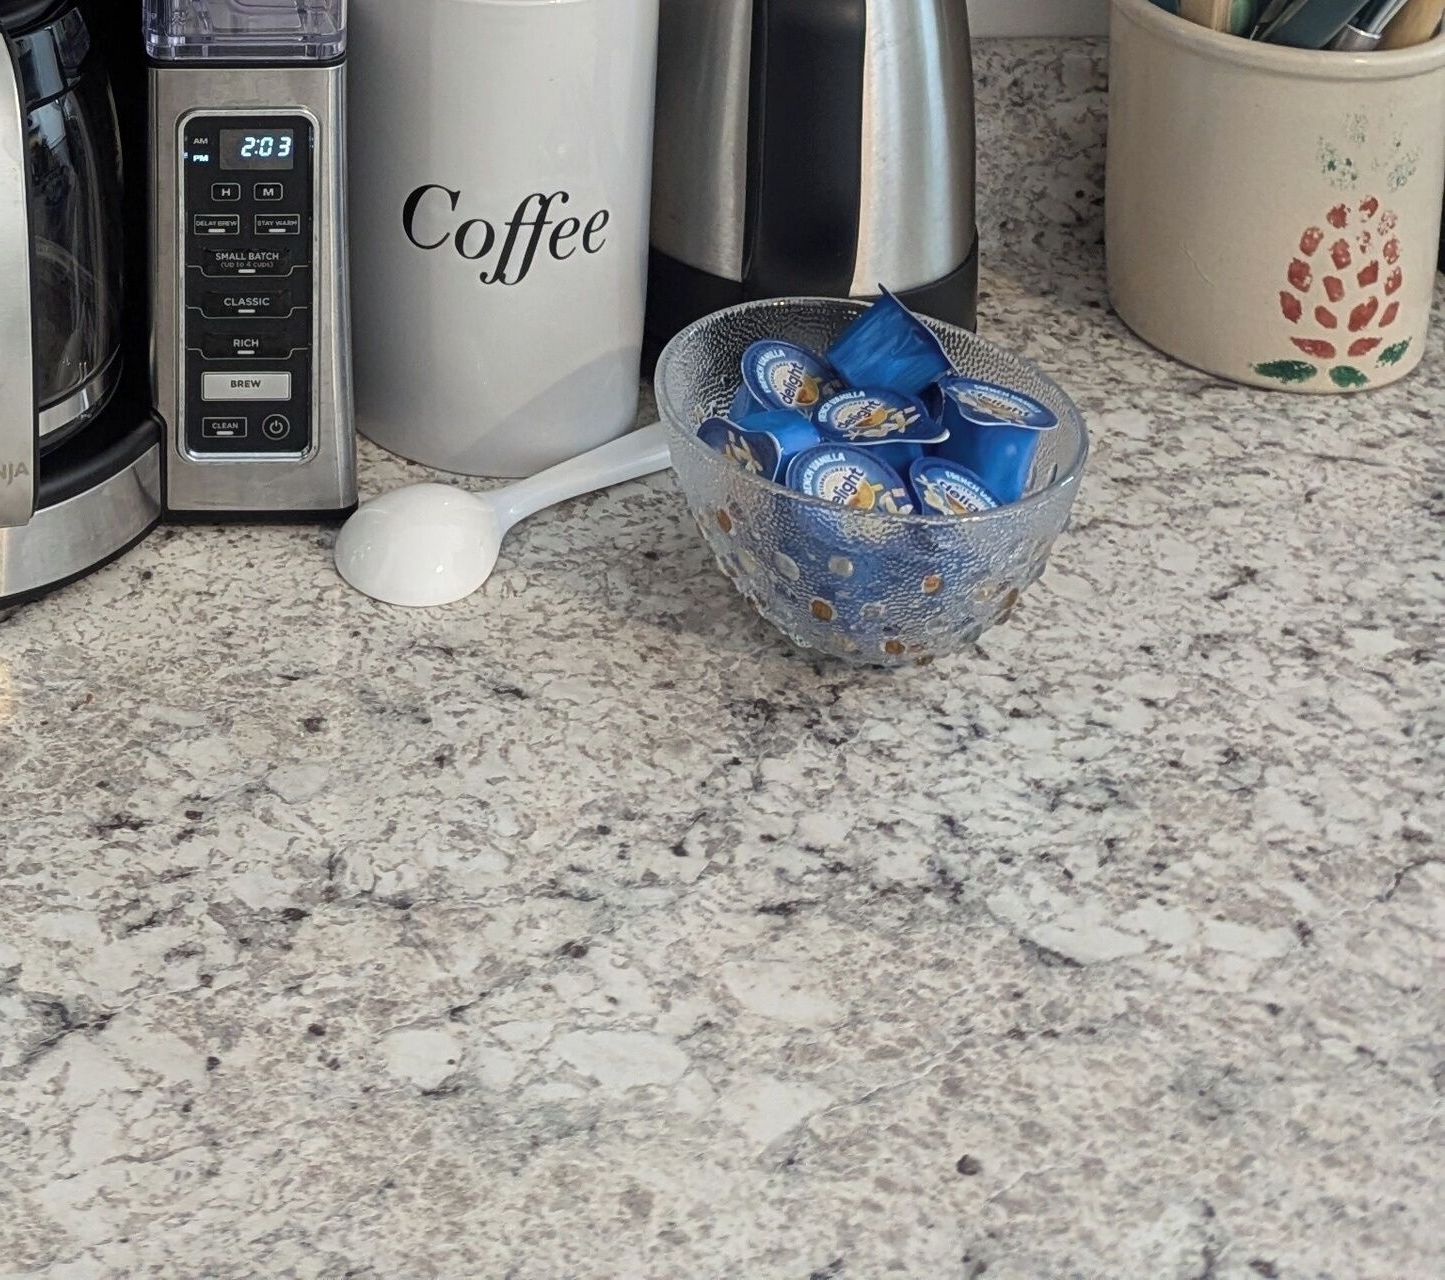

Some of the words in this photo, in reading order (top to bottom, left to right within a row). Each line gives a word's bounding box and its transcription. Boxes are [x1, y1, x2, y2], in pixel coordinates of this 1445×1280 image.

[193, 137, 209, 145] AM
[240, 136, 292, 157] 2:03
[193, 154, 209, 162] PM
[221, 188, 231, 197] H
[263, 188, 274, 197] M
[402, 184, 610, 286] Coffee
[215, 252, 246, 261] SMALL
[248, 252, 279, 261] BATCH
[223, 297, 270, 306] CLASSIC
[233, 338, 259, 348] RICH
[230, 380, 262, 388] BREW
[780, 361, 804, 405] delight
[211, 422, 239, 430] CLEAN
[809, 452, 846, 471] VANILLA
[832, 466, 865, 505] elight
[939, 481, 979, 513] delig
